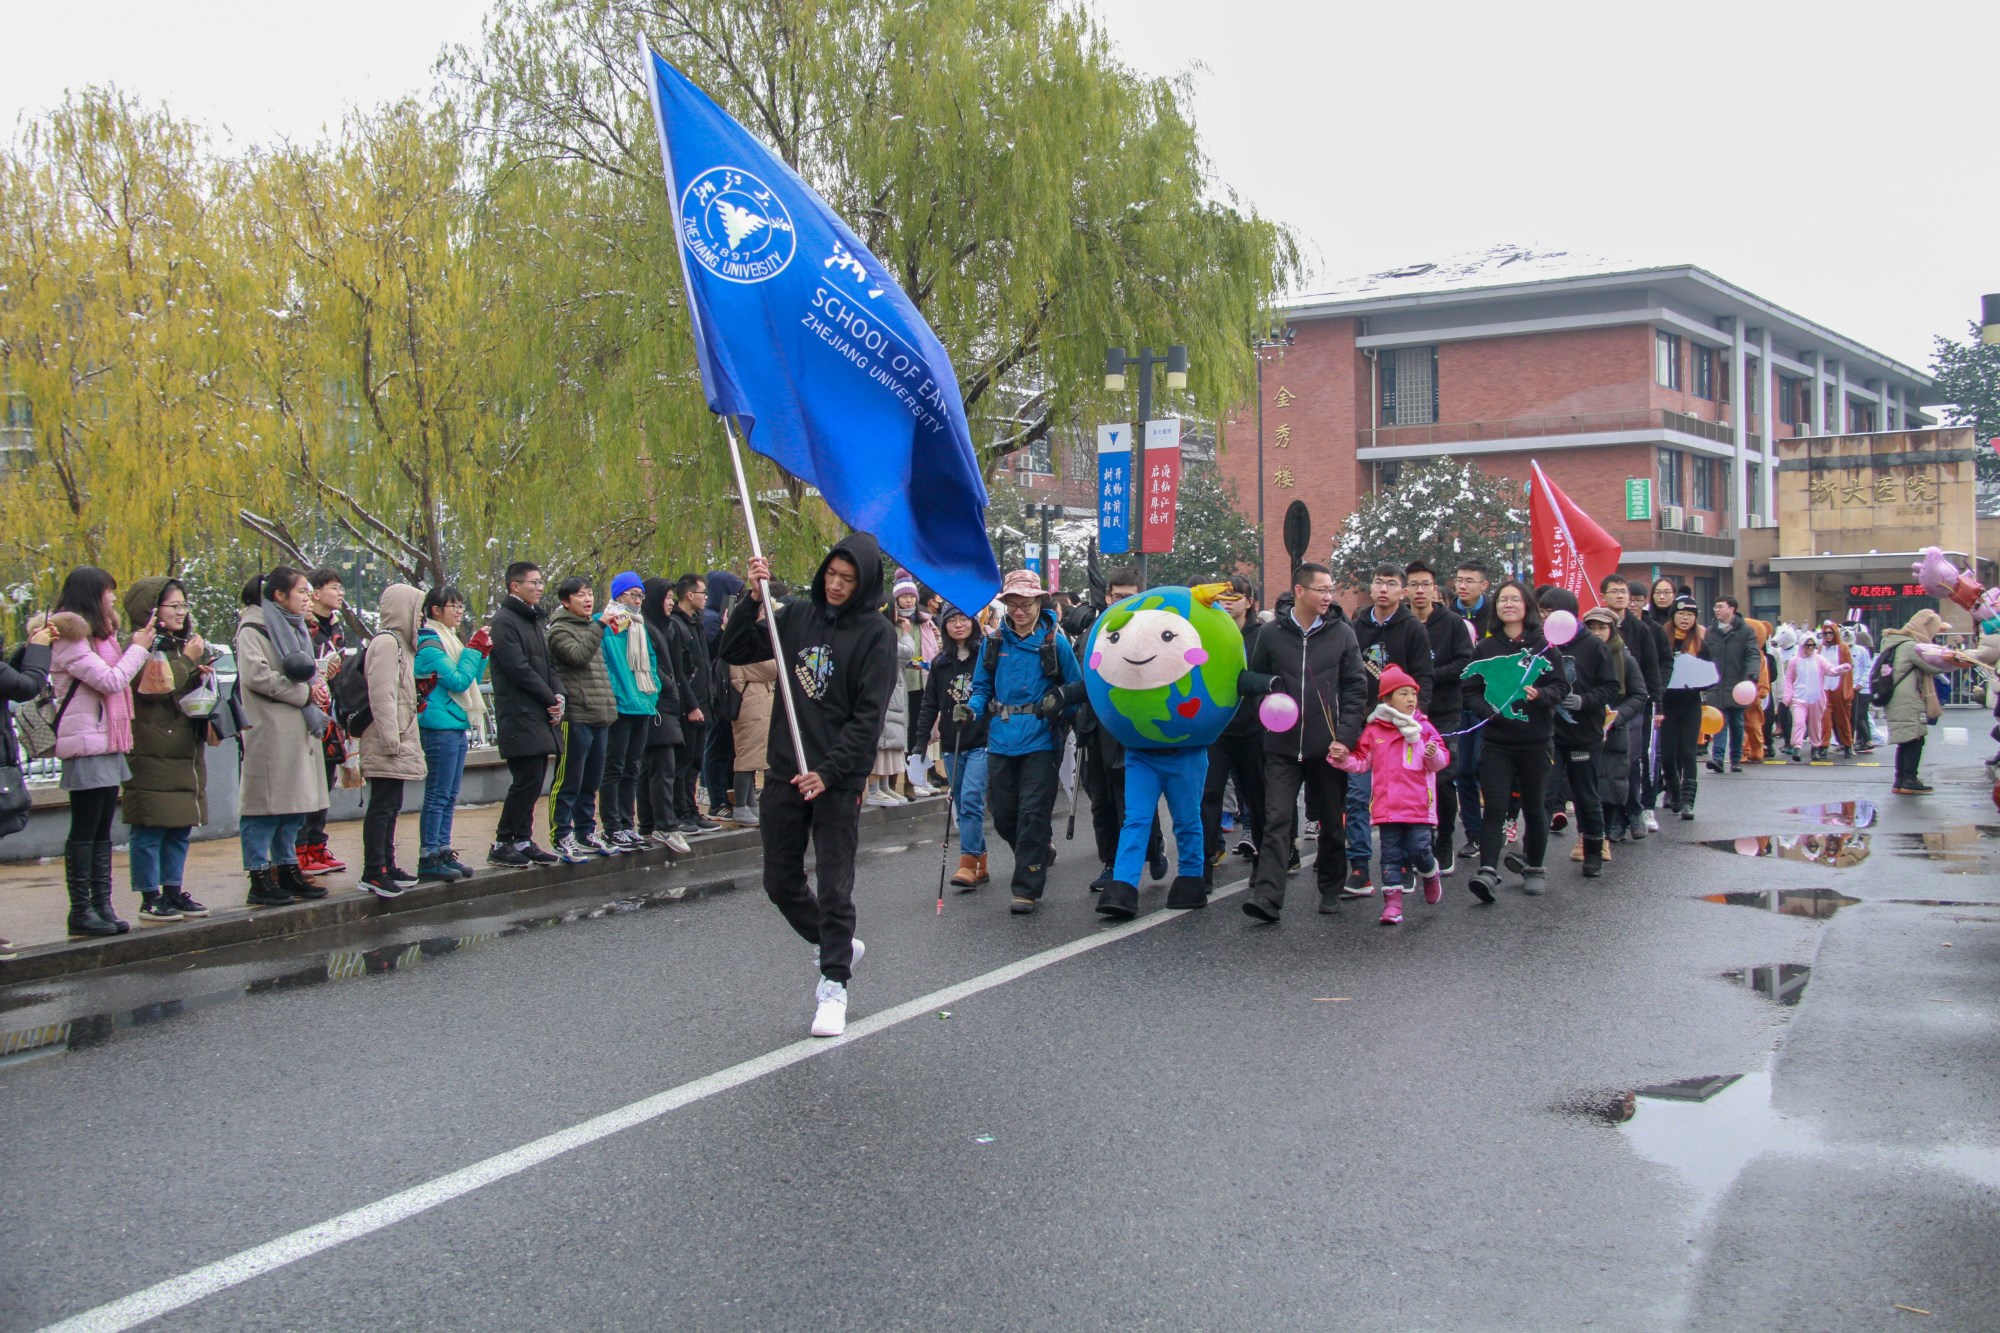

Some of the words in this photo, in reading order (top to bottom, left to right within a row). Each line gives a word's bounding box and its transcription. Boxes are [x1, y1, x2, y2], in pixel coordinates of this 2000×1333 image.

[683, 216, 720, 269] ZHEJIANG
[710, 241, 751, 262] 1897
[801, 311, 869, 370] ZHEJIANG
[869, 365, 945, 434] UNIVERSITY
[811, 287, 888, 359] SCHOOL
[892, 354, 921, 379] OF
[917, 379, 951, 419] EA
[1273, 385, 1297, 490] 金秀楼
[1149, 464, 1160, 525] 启真厚德
[1159, 463, 1171, 525] 海纳江河
[1808, 475, 1938, 510] 浙大医院
